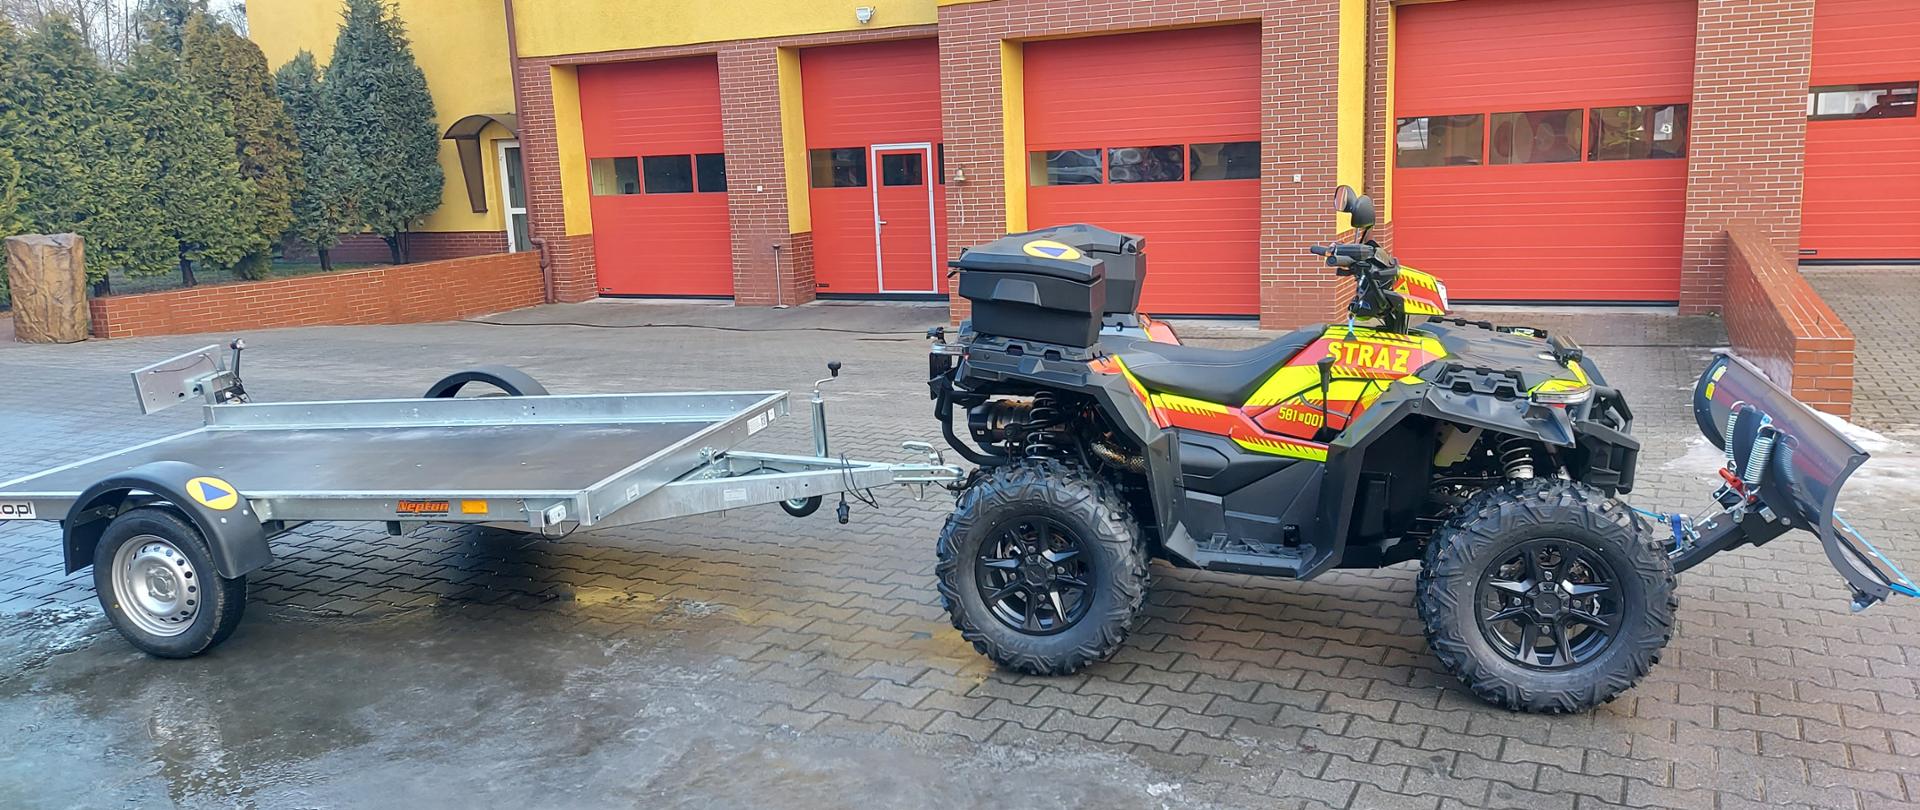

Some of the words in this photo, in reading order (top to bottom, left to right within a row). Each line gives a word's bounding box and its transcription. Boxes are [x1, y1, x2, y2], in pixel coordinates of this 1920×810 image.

[1278, 407, 1297, 421] 581
[0, 501, 32, 517] o.pl
[397, 501, 449, 514] Neptun
